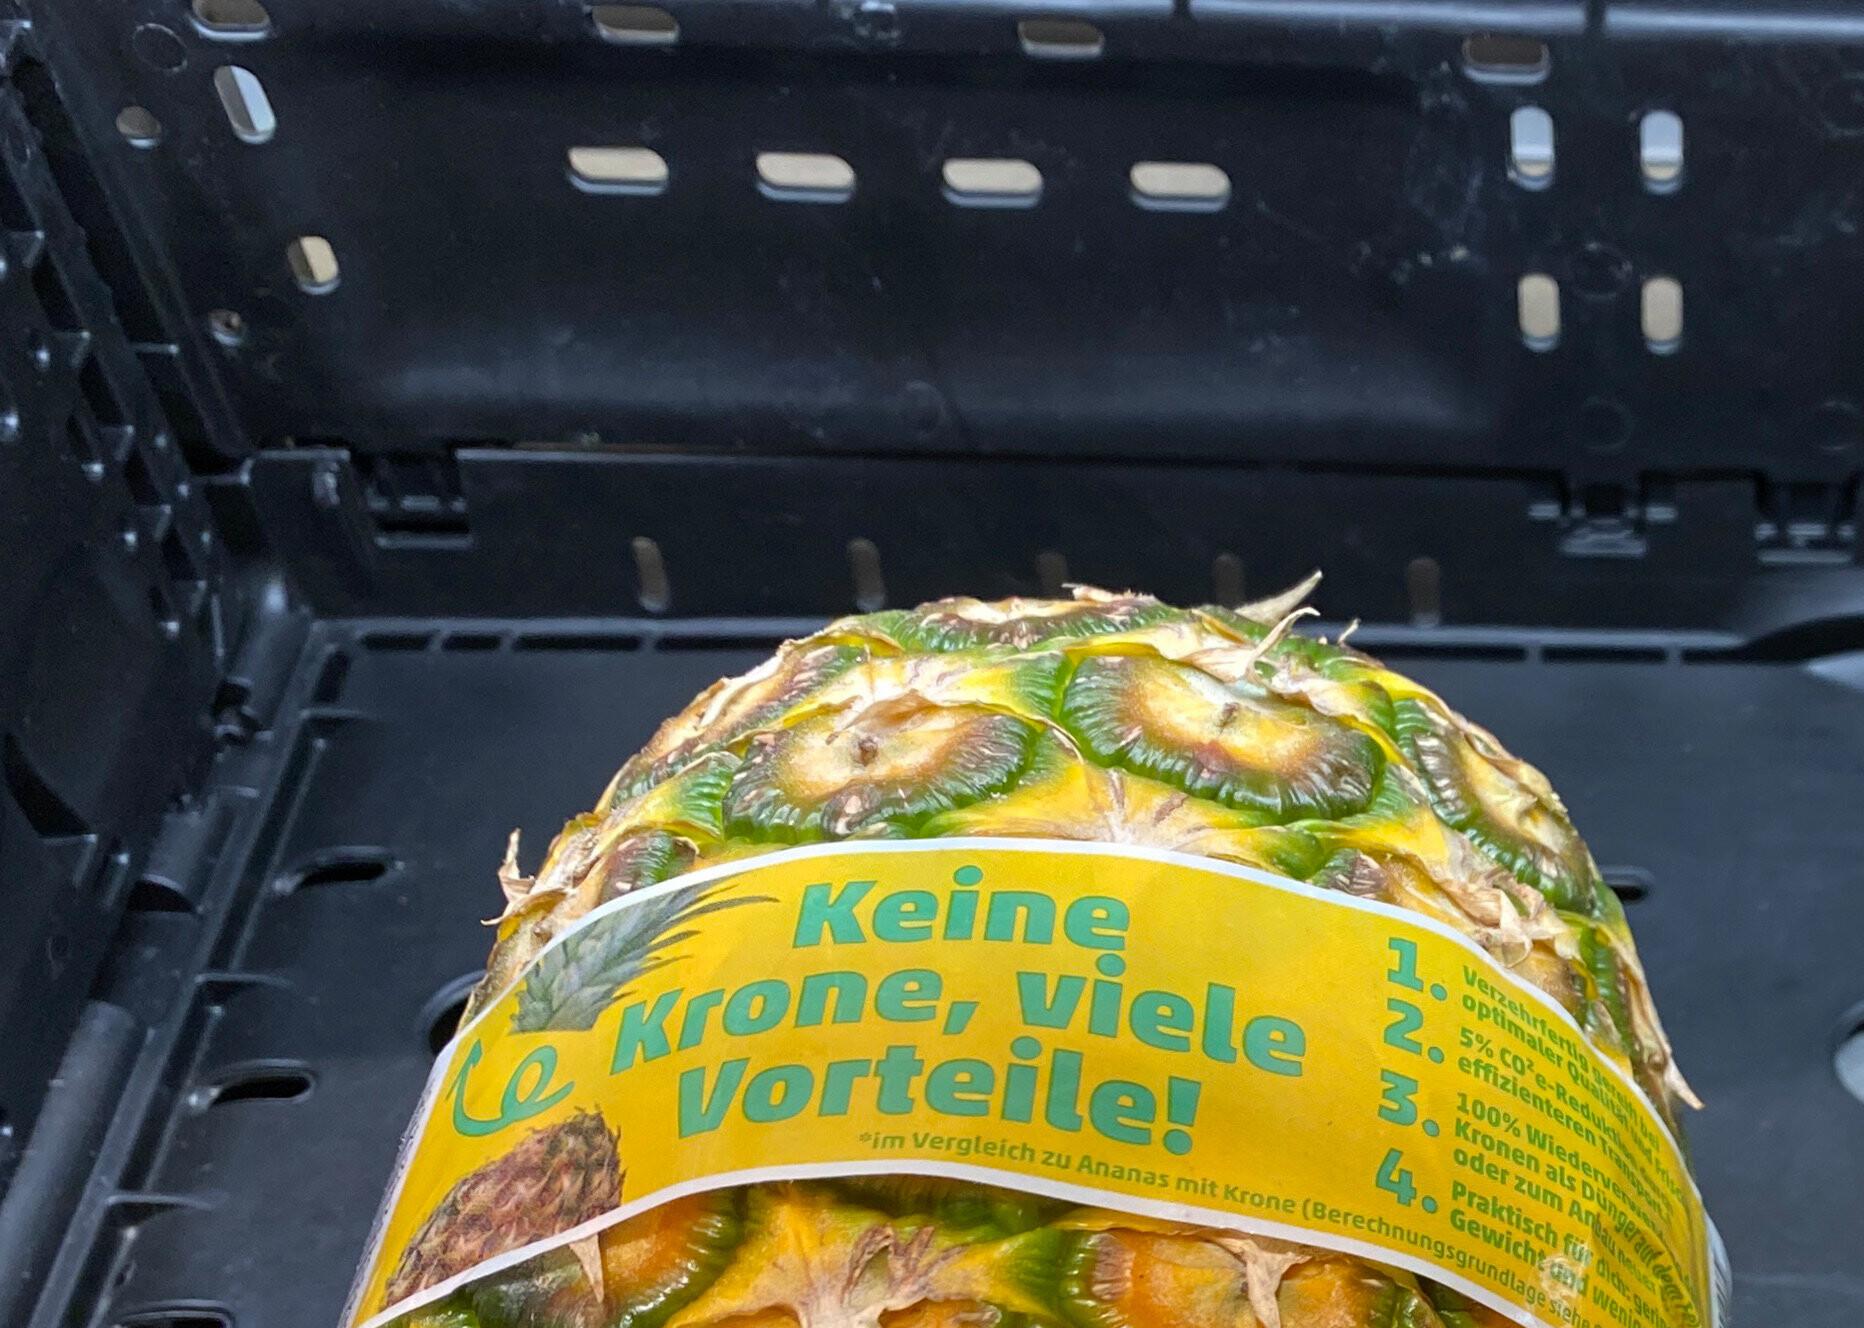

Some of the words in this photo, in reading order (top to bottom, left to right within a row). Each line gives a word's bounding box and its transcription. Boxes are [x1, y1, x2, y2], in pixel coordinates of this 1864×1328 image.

[792, 865, 1130, 950] Keine
[1386, 937, 1448, 1001] 1.
[610, 968, 980, 1076] Krone,
[1016, 953, 1306, 1076] viele
[1384, 997, 1446, 1064] 2.
[1459, 1026, 1494, 1059] 5%
[1462, 994, 1564, 1069] optimaler
[1463, 965, 1591, 1074] Verzehrfertig
[678, 1036, 1202, 1156] Vorteile!
[1378, 1068, 1440, 1138] 3.
[1456, 1092, 1521, 1139] 100%
[1458, 1056, 1597, 1147] effizienteren
[1374, 1147, 1439, 1215] 4.
[1453, 1147, 1510, 1185] oder
[1514, 1175, 1563, 1213] zum
[1455, 1118, 1541, 1174] Kronen
[1546, 1162, 1576, 1193] als
[1582, 1181, 1640, 1243] Dünger
[912, 1132, 1036, 1163] Vergleich
[1042, 1151, 1071, 1170] zu
[1077, 1154, 1170, 1188] Ananas
[1176, 1177, 1220, 1198] mit
[1224, 1184, 1296, 1214] Krone
[1302, 1198, 1547, 1309] (Berechnungsgrundlage
[1450, 1208, 1547, 1272] Gewicht
[1452, 1181, 1558, 1249] Praktisch
[1563, 1232, 1593, 1268] für
